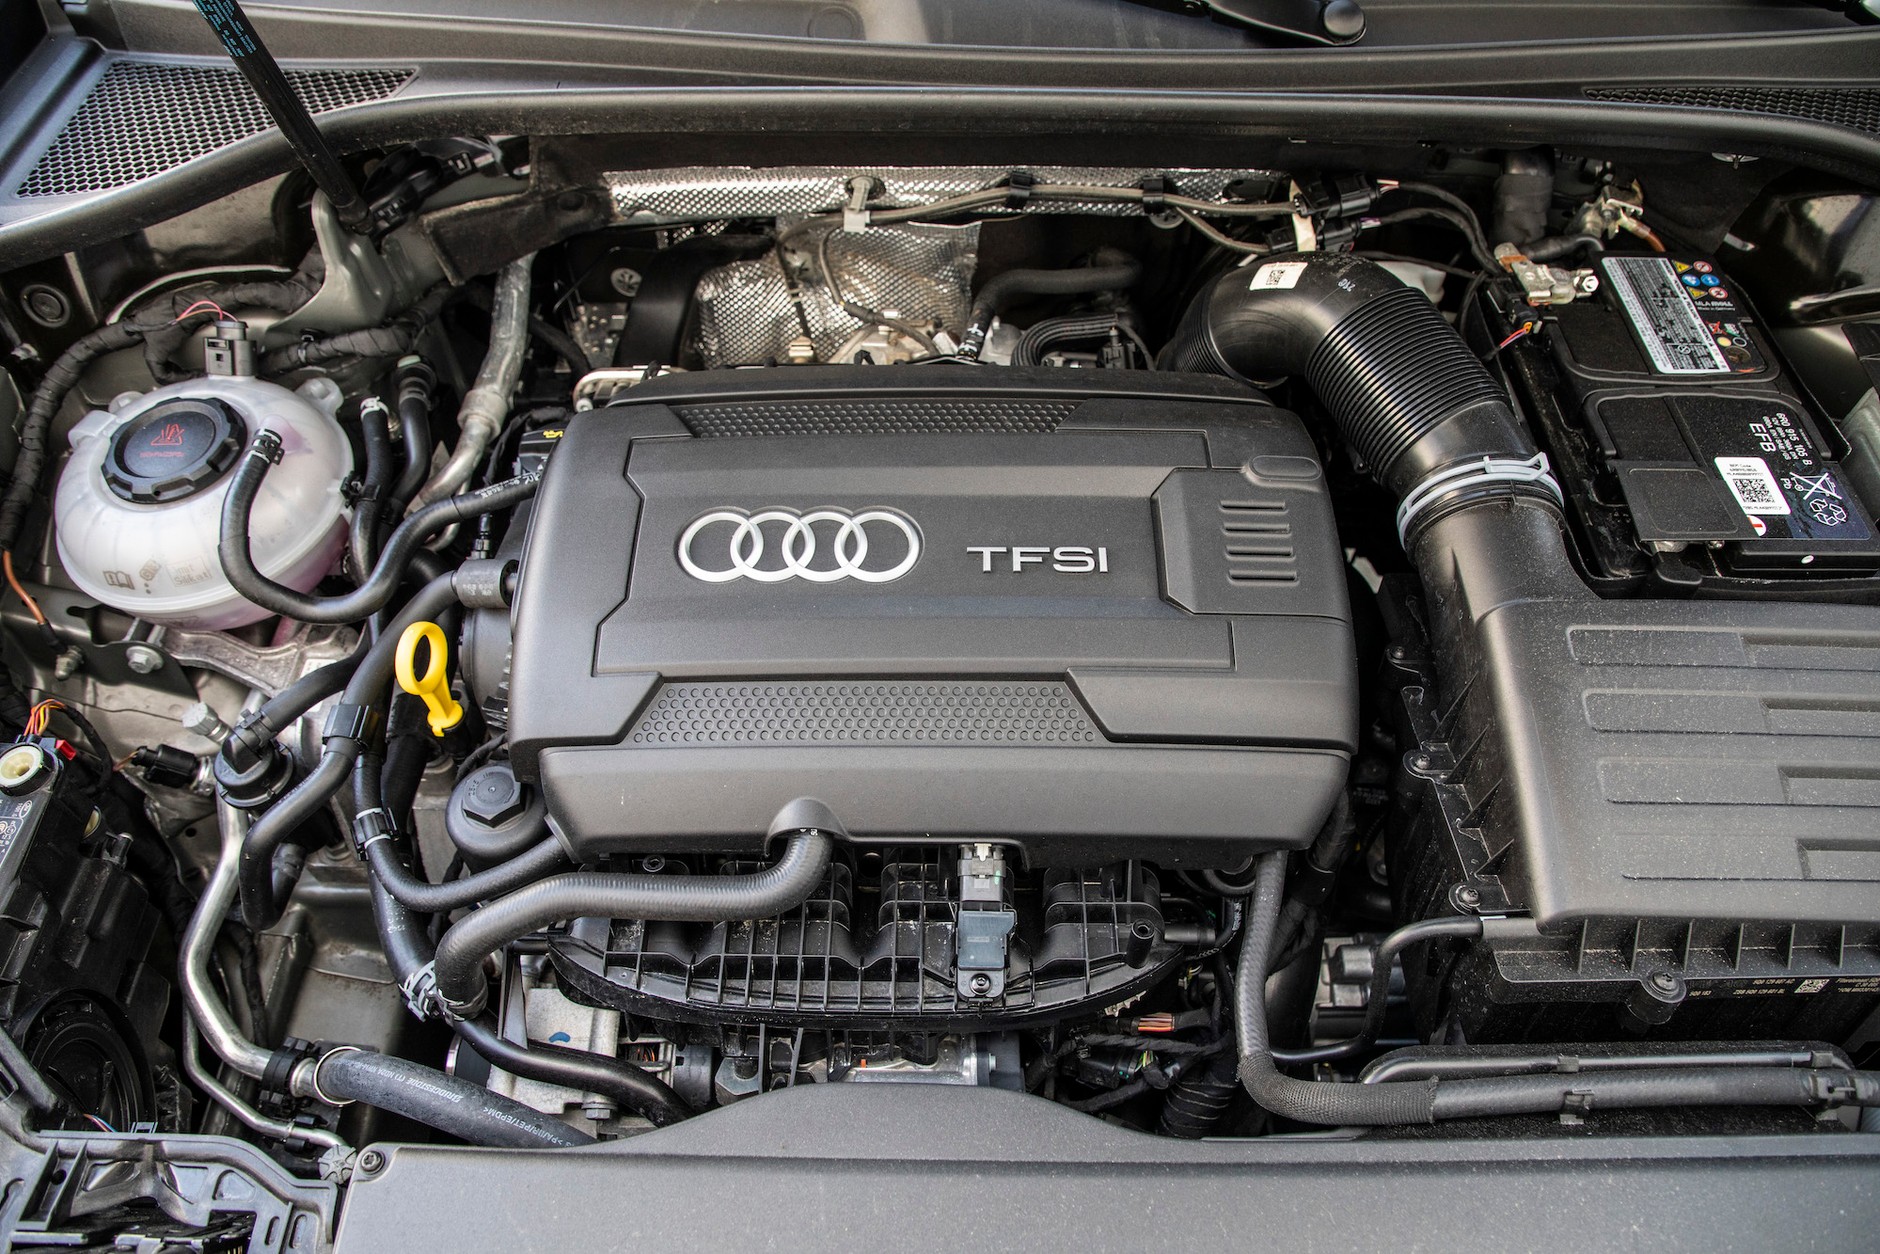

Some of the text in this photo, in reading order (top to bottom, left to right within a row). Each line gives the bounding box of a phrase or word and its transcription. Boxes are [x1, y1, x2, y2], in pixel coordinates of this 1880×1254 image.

[1749, 423, 1776, 452] EFB
[1785, 428, 1800, 442] 915
[1794, 444, 1808, 457] 105
[1780, 478, 1792, 490] Pb
[966, 547, 1109, 573] TFSI
[406, 1077, 464, 1103] BRIDGESTONE
